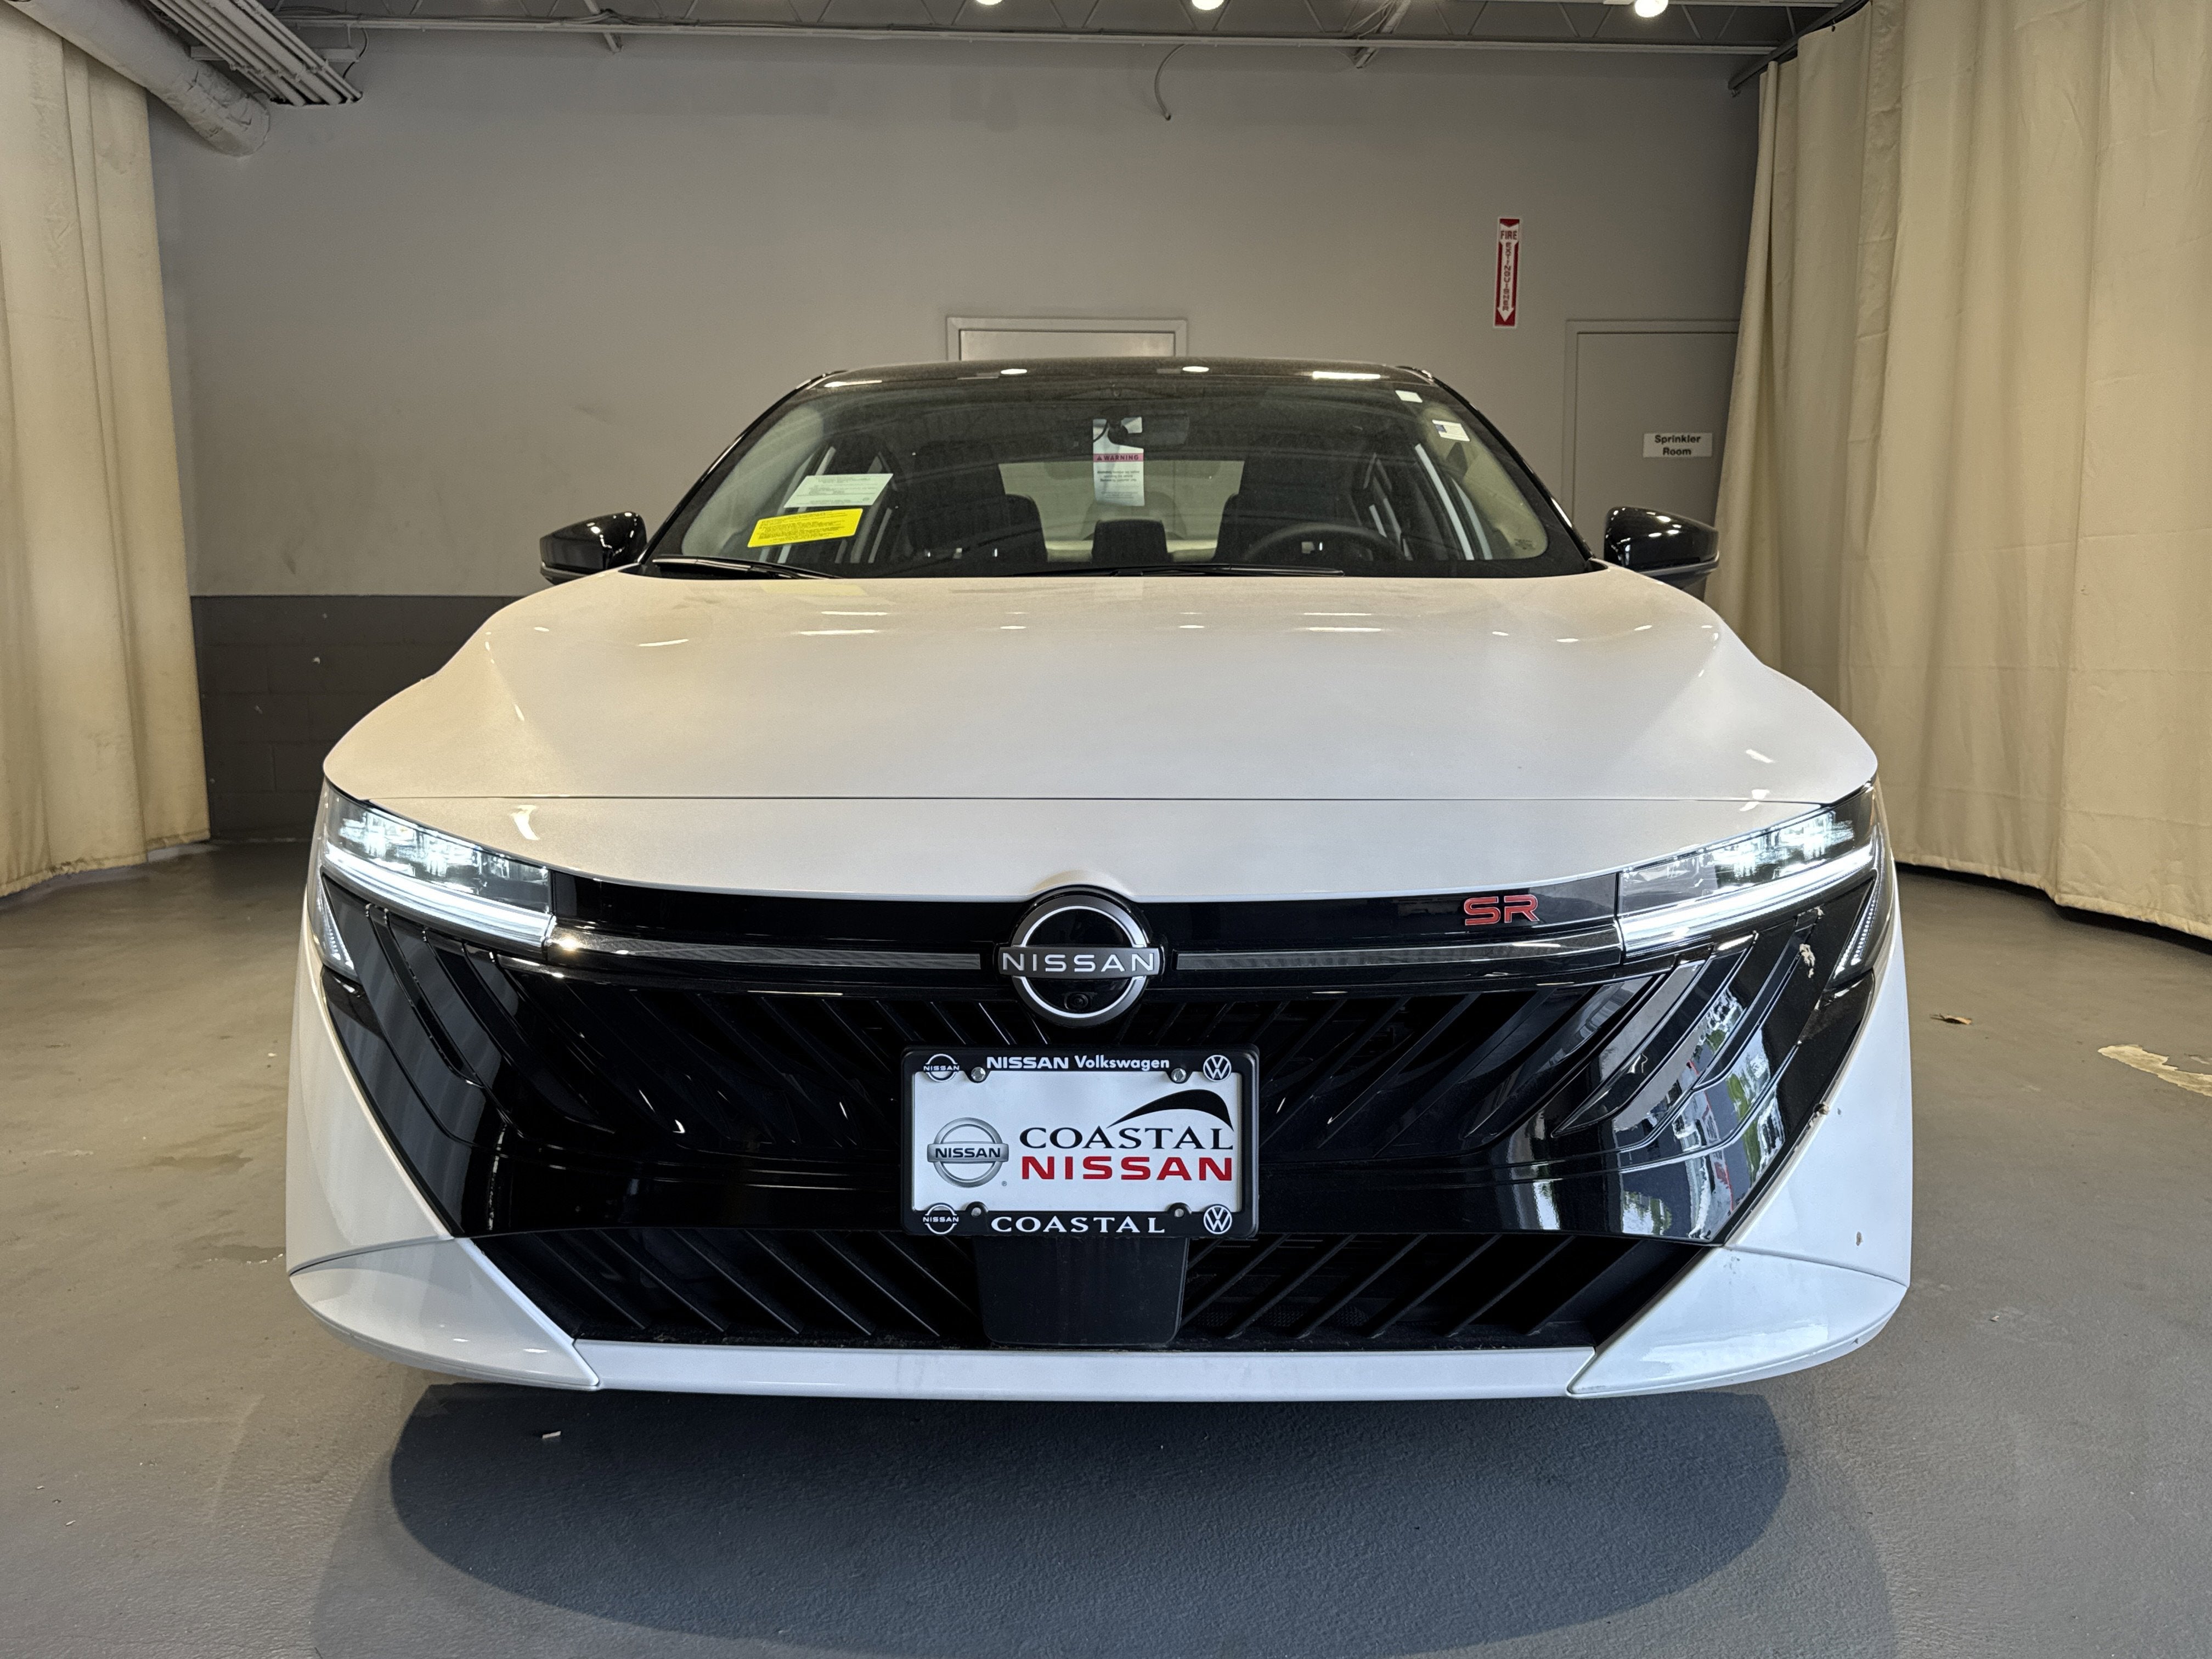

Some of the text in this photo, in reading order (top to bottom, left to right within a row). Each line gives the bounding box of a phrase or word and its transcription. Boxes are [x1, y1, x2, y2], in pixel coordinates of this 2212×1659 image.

[1500, 230, 1517, 240] FIRE
[1502, 242, 1512, 311] EXTINGUISHER
[1655, 435, 1701, 444] Sprinkler
[1663, 447, 1691, 455] Room
[1464, 894, 1540, 926] SR
[1002, 952, 1154, 972] NISSAN
[986, 1054, 1170, 1071] NISSAN Volkswagen
[1019, 1126, 1233, 1150] COASTAL
[935, 1147, 1001, 1159] NISSAN
[1022, 1156, 1232, 1181] NISSAN
[991, 1216, 1165, 1233] COASTAL
